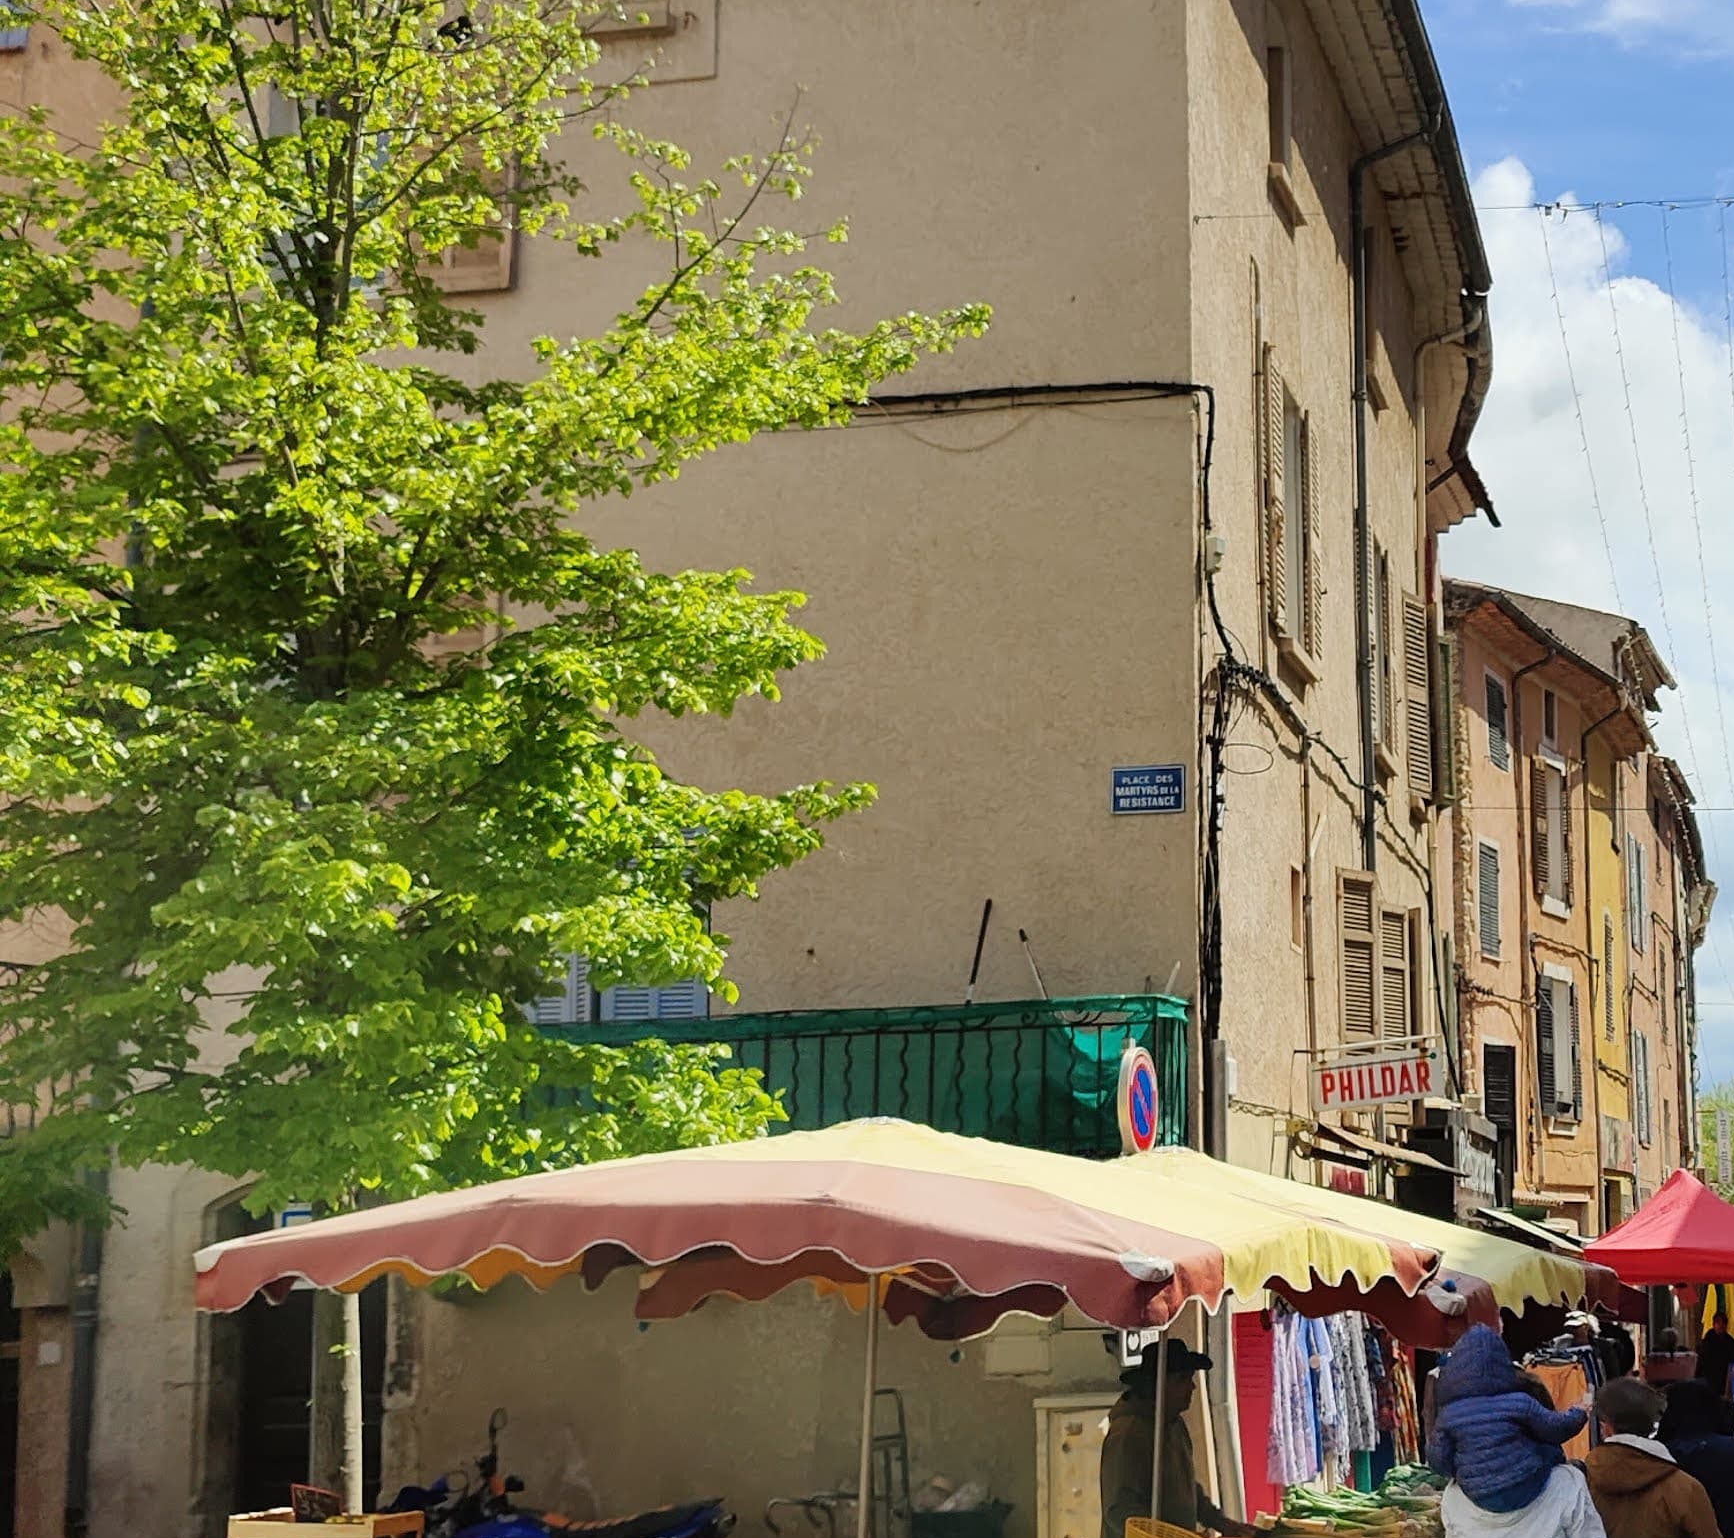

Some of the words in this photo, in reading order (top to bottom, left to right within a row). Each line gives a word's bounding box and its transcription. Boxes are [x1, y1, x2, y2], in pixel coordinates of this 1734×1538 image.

[1122, 774, 1150, 785] PLACE
[1155, 773, 1174, 784] DES
[1115, 784, 1159, 797] MARTYRS
[1170, 785, 1180, 795] LA
[1320, 1057, 1432, 1105] PHILDAR
